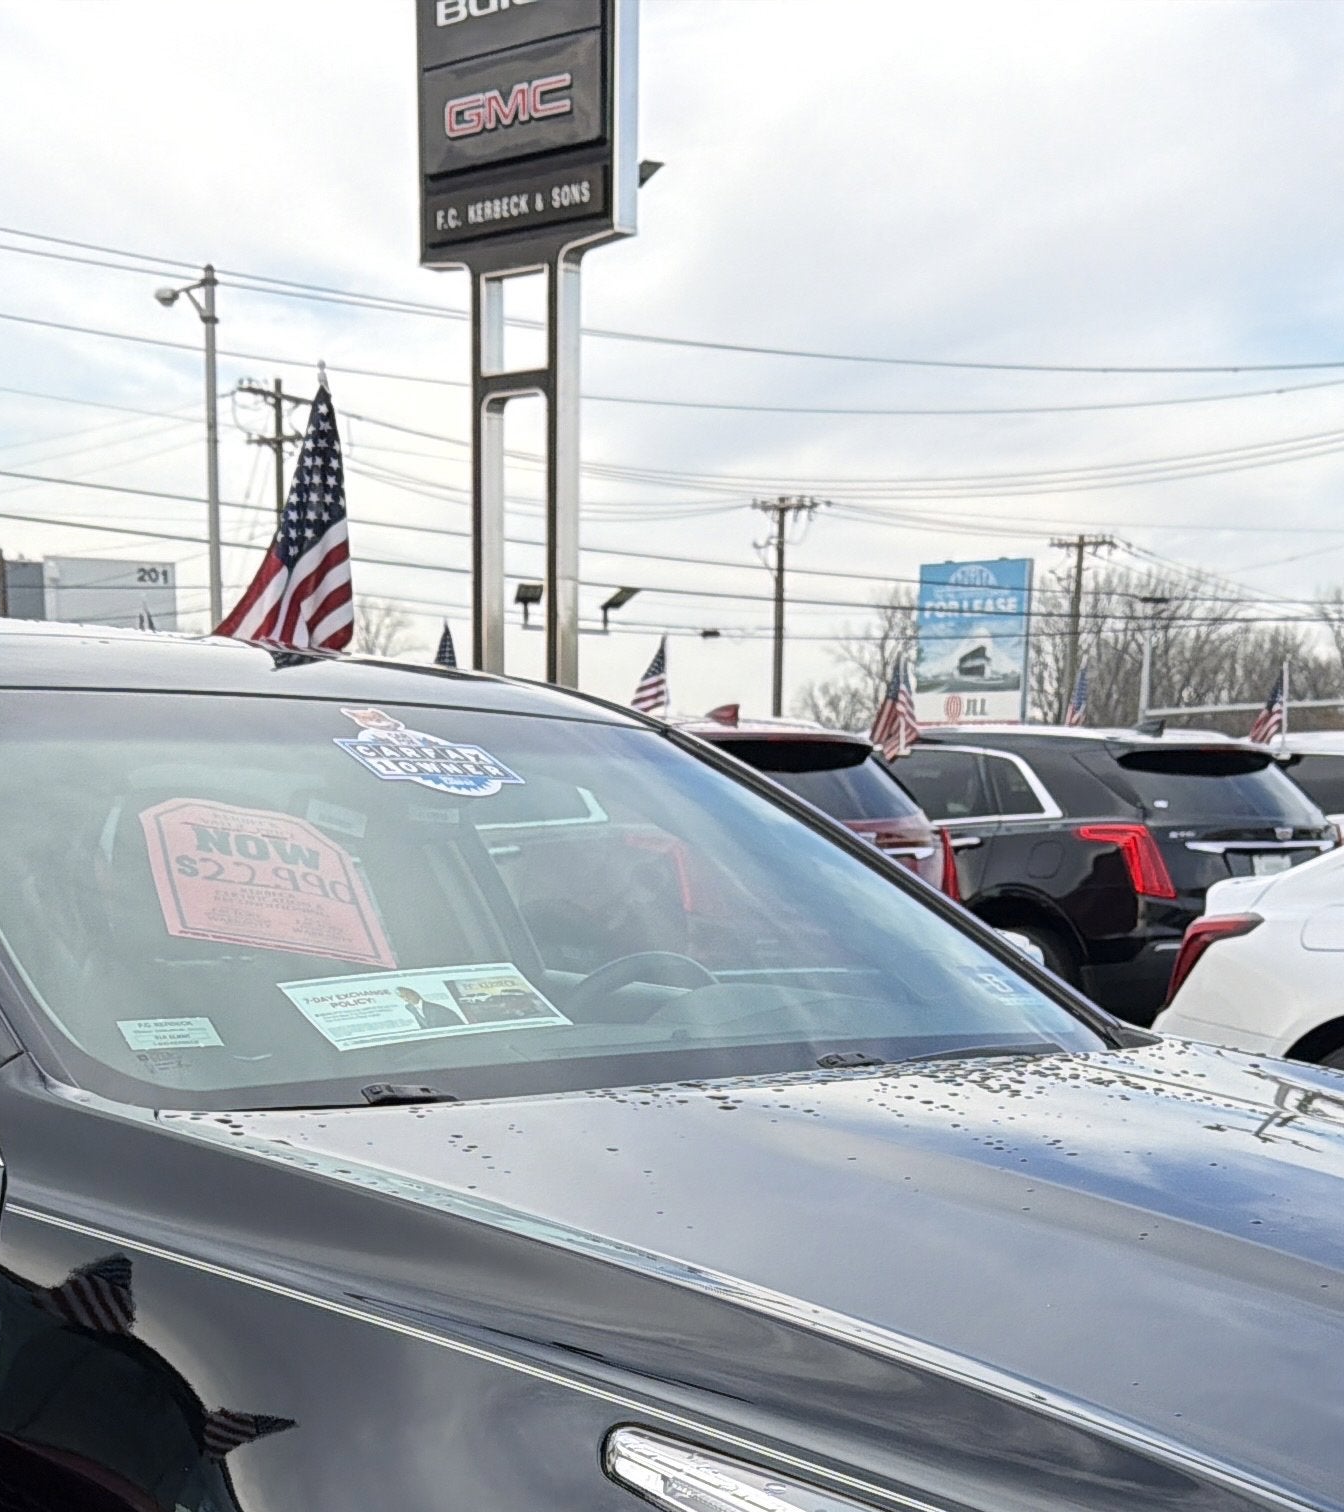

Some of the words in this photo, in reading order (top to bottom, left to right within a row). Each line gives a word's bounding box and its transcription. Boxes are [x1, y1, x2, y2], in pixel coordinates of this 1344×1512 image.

[445, 72, 572, 138] GMC
[436, 207, 462, 230] F.C.
[468, 193, 529, 224] KERBECK
[535, 192, 544, 212] &
[551, 180, 591, 209] SONS
[137, 567, 169, 585] 201
[923, 601, 960, 619] FOR
[962, 597, 1018, 618] LEASE
[356, 745, 490, 764] CARFAX
[399, 760, 506, 777] OWNER
[193, 825, 320, 871] NOW
[335, 988, 393, 1000] EXCHANGE
